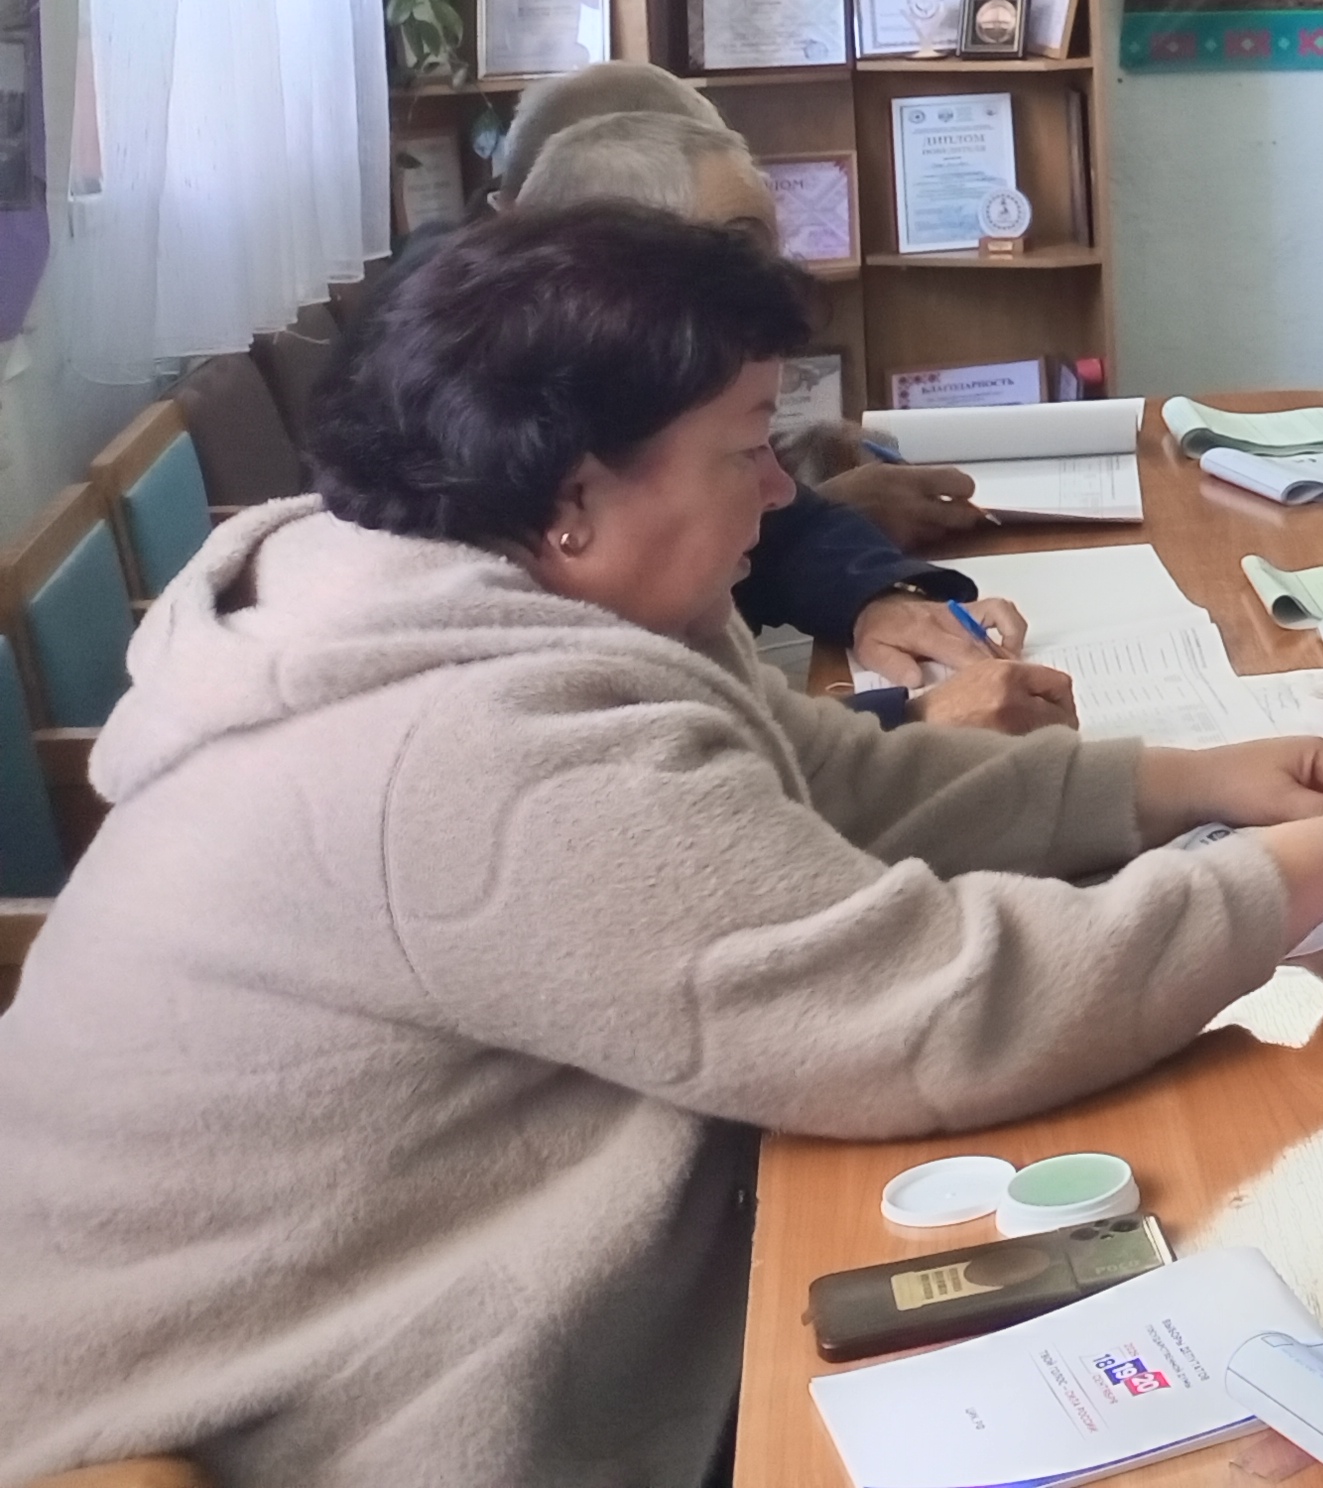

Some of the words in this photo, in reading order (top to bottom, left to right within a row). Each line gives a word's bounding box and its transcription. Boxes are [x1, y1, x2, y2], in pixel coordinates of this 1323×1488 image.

[923, 133, 986, 148] ДИПЛОМ
[1090, 1352, 1116, 1369] 18
[1108, 1361, 1139, 1380] 19
[1129, 1371, 1162, 1394] 20
